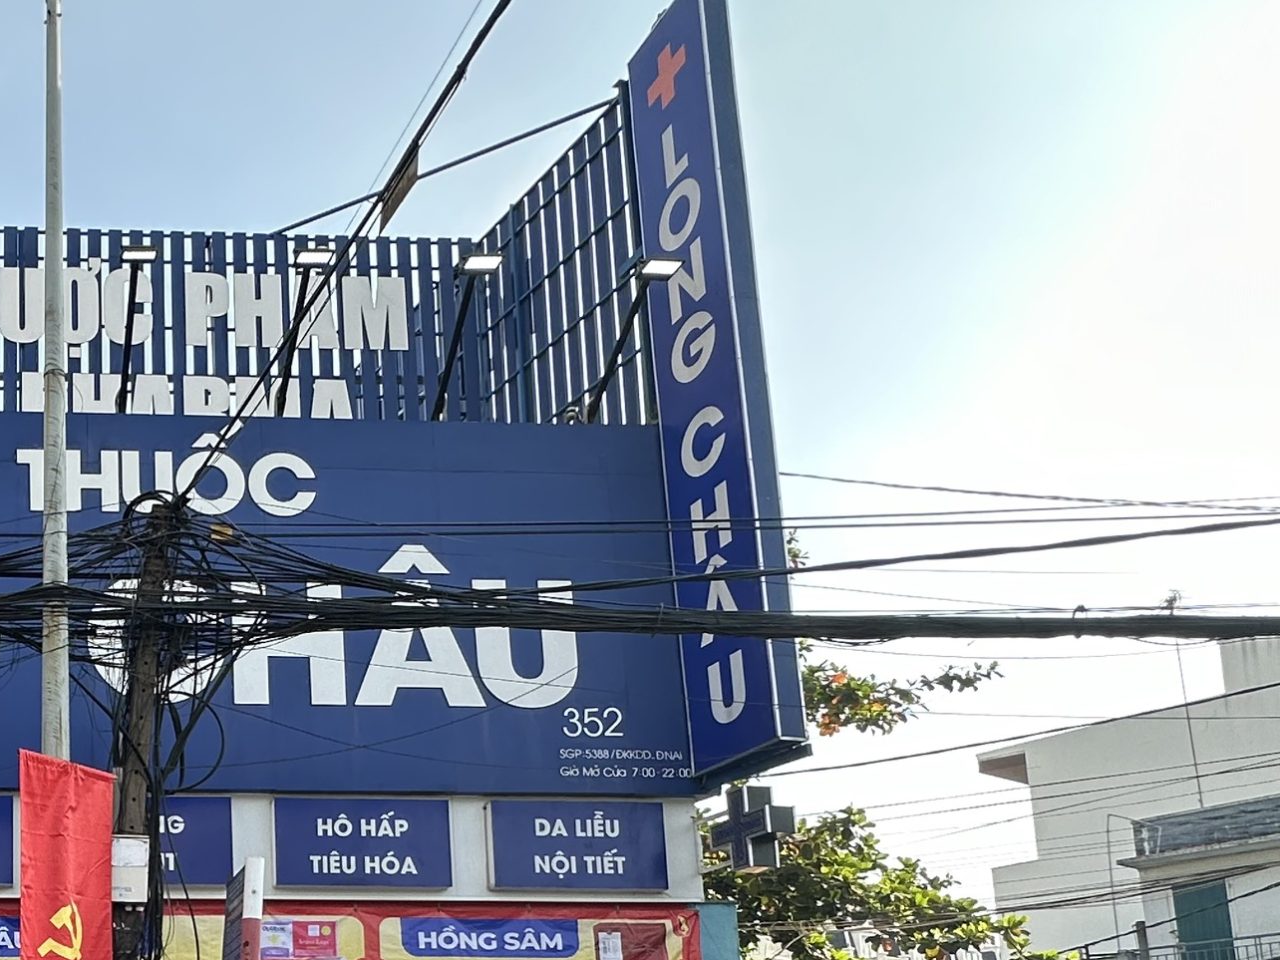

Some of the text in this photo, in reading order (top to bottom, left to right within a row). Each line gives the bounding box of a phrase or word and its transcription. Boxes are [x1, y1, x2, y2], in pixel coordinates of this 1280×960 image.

[658, 126, 716, 384] LONG
[16, 420, 317, 517] THUỐC
[562, 706, 625, 738] 352
[316, 811, 410, 838] HÔ HẤP
[534, 810, 620, 838] DA LIỄU
[309, 853, 418, 876] TIÊU HÓA
[534, 849, 626, 880] NỘI TIẾT
[417, 923, 564, 951] HỒNG SÂM
